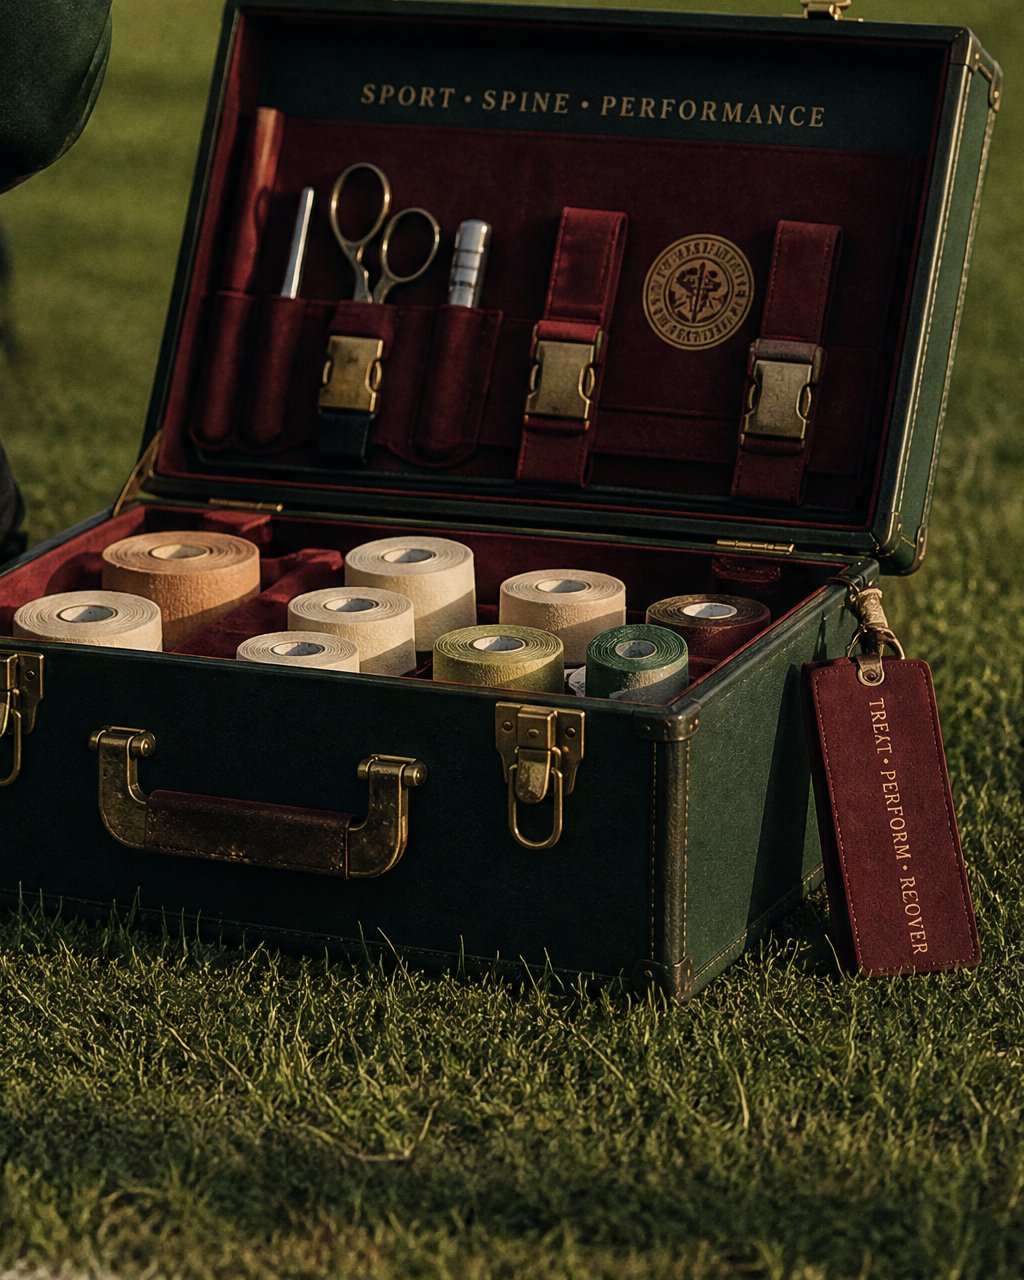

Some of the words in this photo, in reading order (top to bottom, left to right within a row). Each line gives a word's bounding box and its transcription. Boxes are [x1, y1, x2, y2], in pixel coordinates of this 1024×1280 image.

[361, 83, 455, 109] SPORT
[482, 89, 570, 114] SPINE
[600, 95, 825, 128] PERFORMANCE
[880, 769, 912, 860] PERFORM
